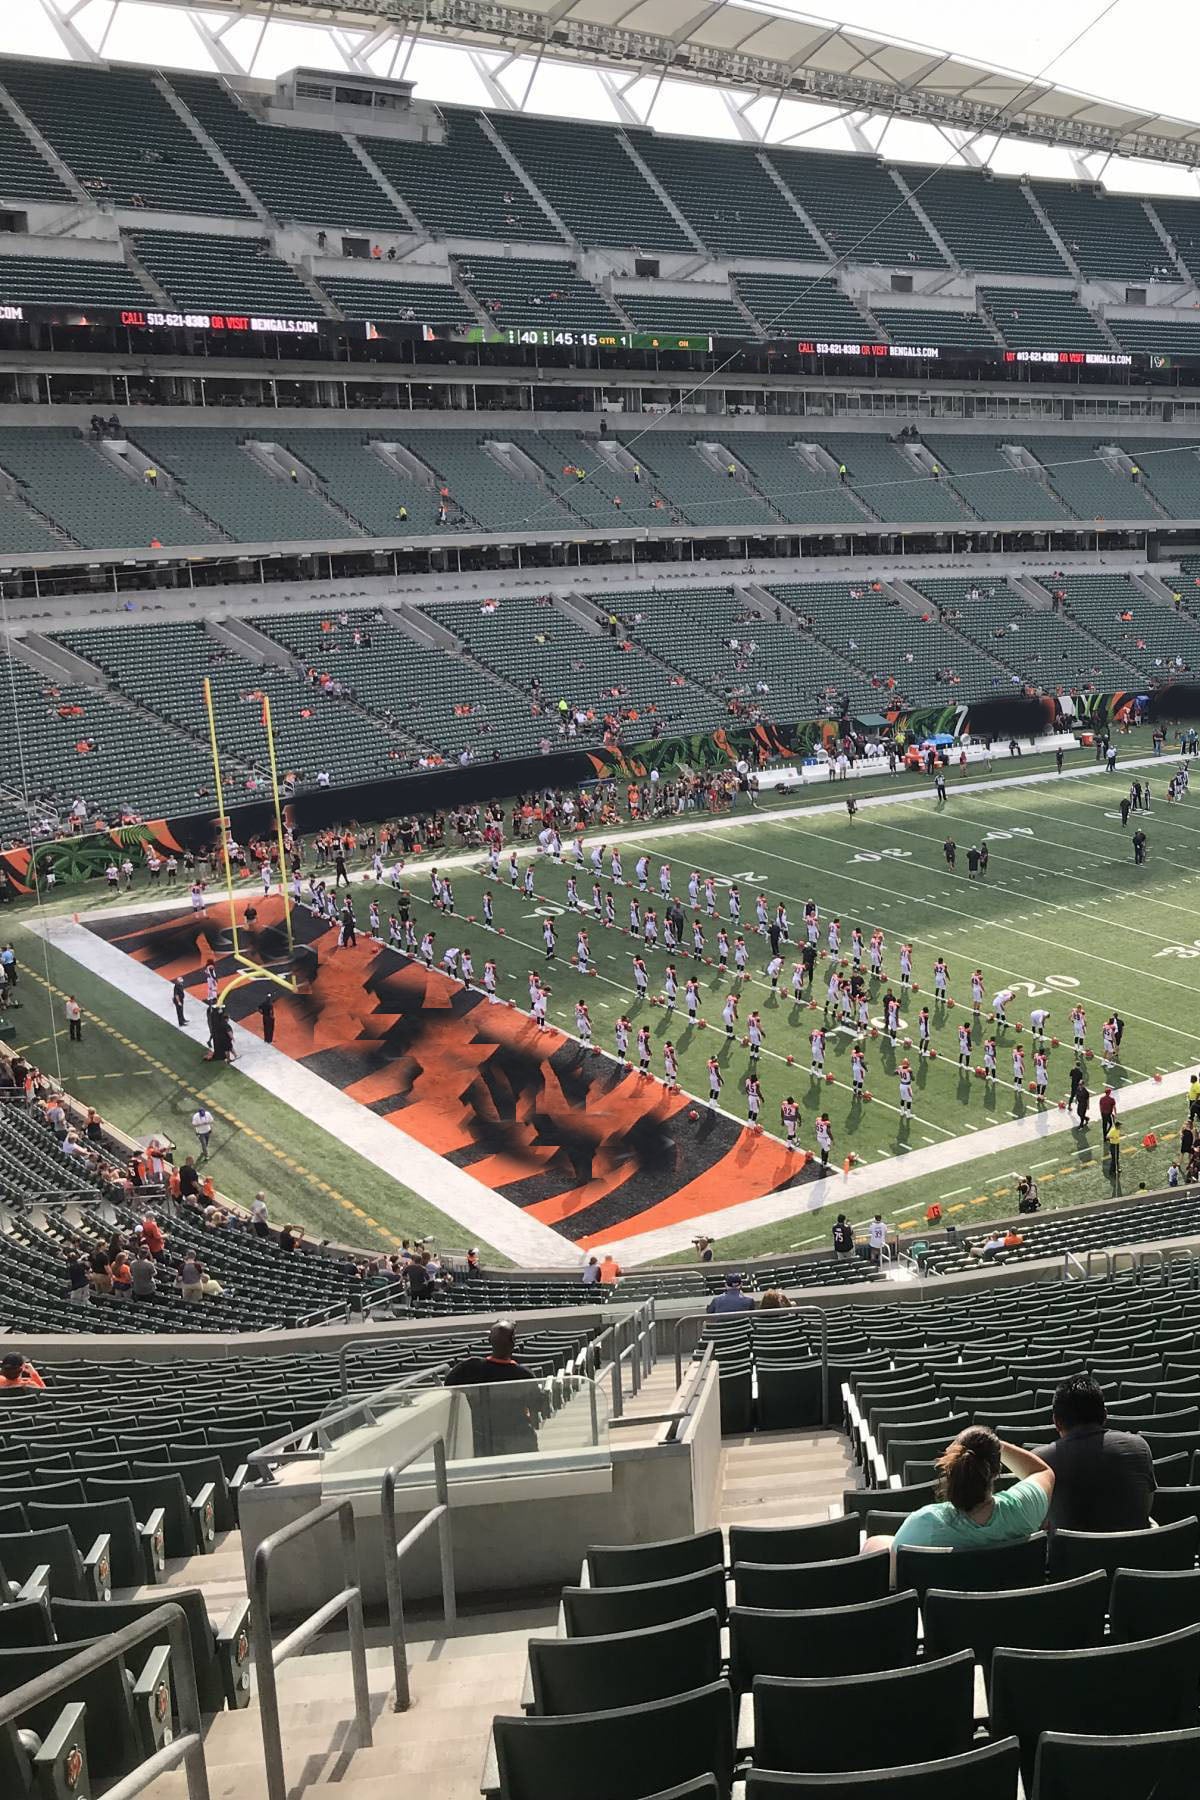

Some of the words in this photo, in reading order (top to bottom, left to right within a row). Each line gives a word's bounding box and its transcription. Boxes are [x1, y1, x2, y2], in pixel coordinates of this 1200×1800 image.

[121, 311, 145, 326] CALL
[211, 316, 225, 330] OR
[226, 316, 249, 331] VISIT
[250, 318, 318, 334] BENGALS.COM
[520, 331, 538, 344] 40
[555, 332, 598, 346] 45:15
[599, 337, 616, 345] QTR
[620, 336, 626, 346] 1
[798, 342, 815, 354] CALL
[861, 345, 872, 355] OR
[889, 346, 939, 358] BENGALS.COM
[1085, 353, 1132, 365] BENGALS.COM
[834, 1231, 843, 1242] 75
